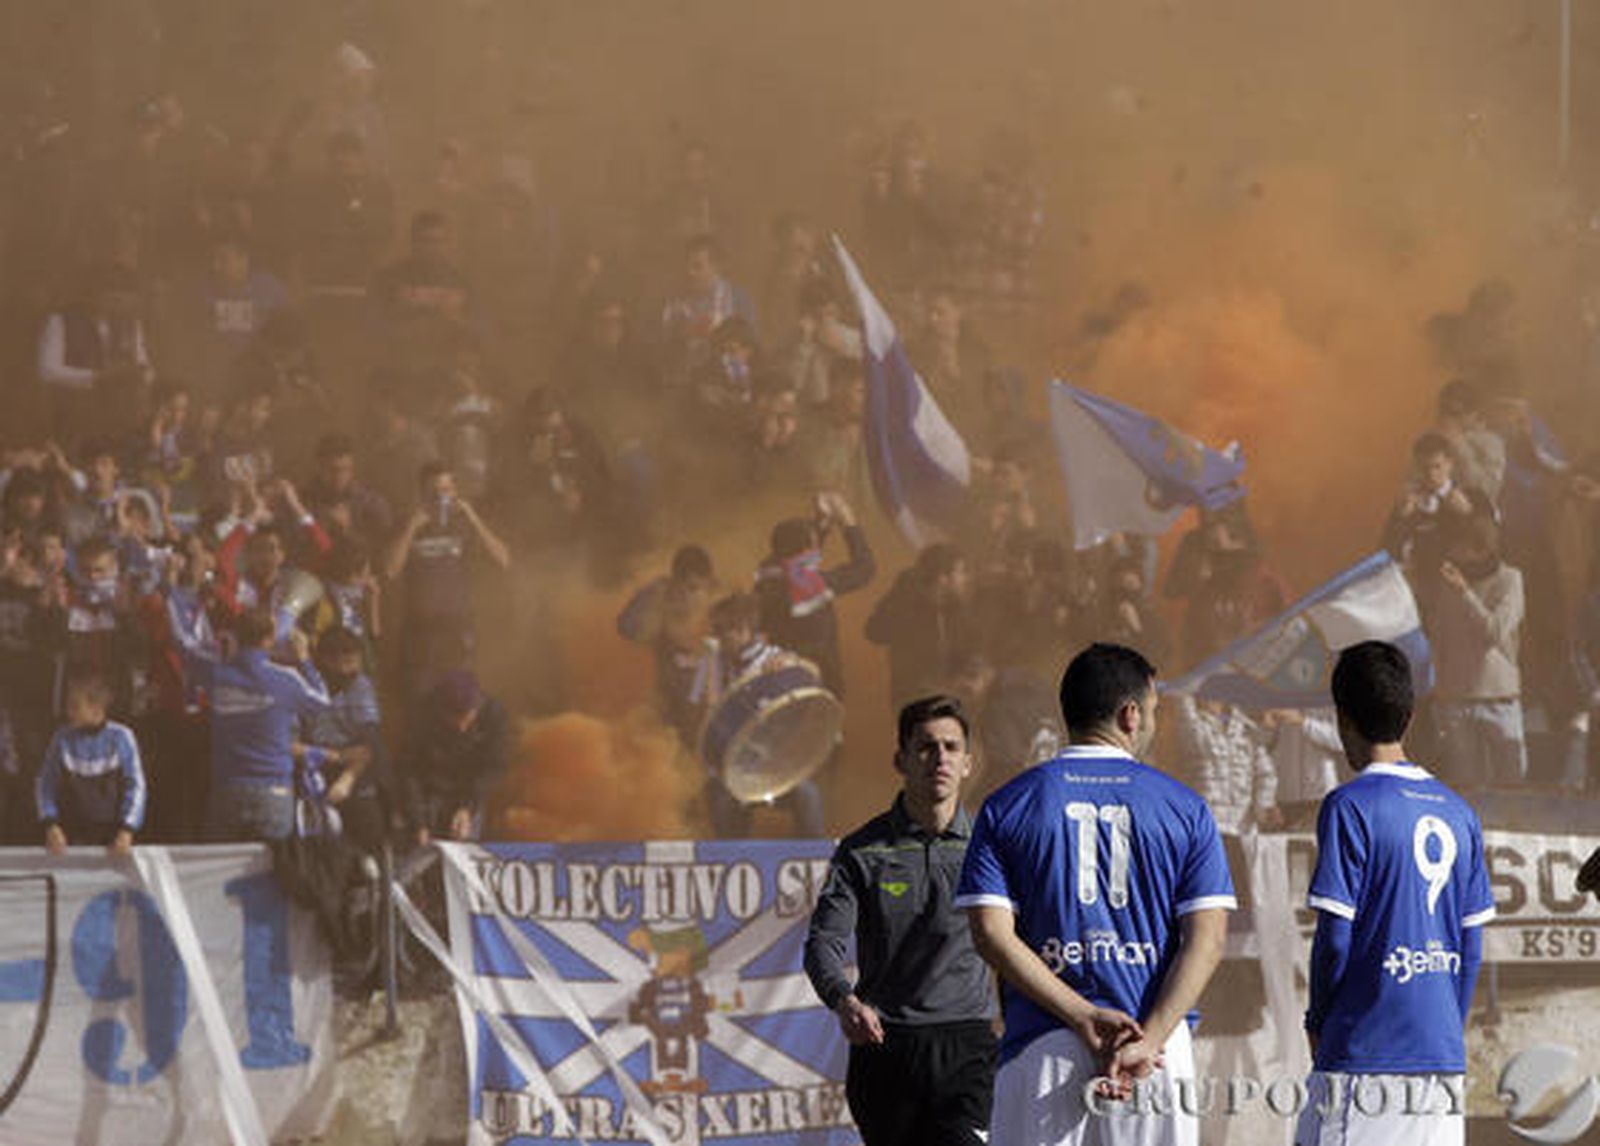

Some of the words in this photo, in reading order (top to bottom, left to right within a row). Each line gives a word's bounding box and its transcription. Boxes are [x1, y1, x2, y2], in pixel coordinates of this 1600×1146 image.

[1065, 801, 1132, 909] 11
[1413, 814, 1458, 916] 9
[71, 873, 313, 1086] 91
[480, 1088, 686, 1143] ULTRAS
